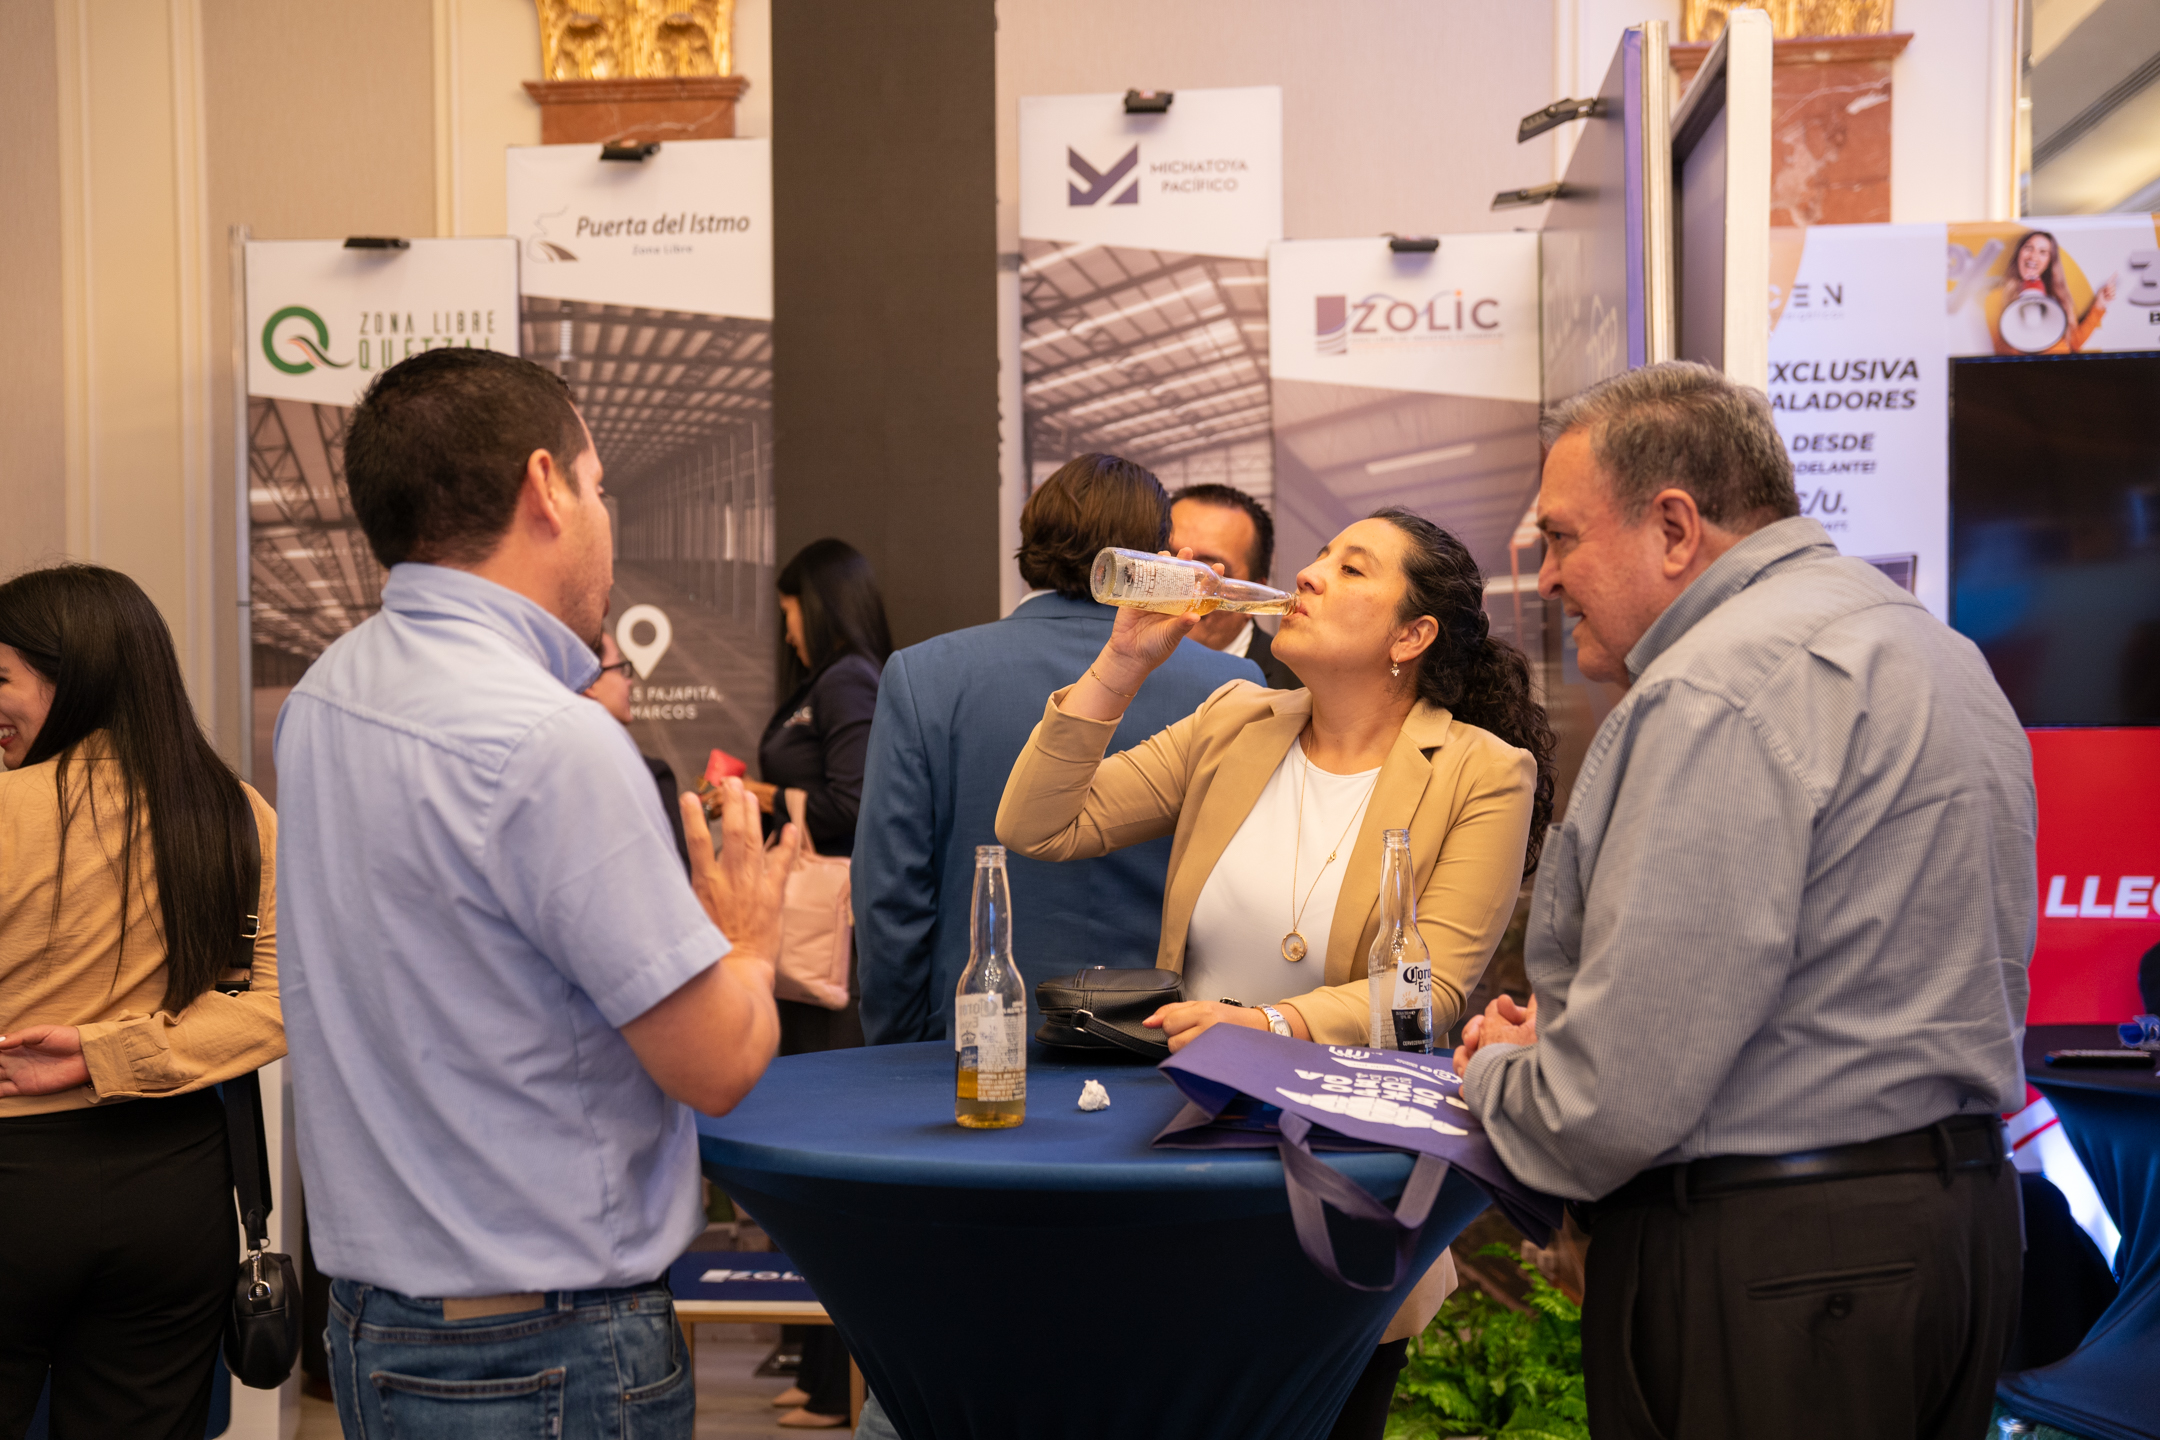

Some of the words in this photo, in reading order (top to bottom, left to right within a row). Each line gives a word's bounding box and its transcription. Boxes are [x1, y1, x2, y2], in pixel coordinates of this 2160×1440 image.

[1149, 160, 1248, 174] MICHATOYA
[576, 214, 647, 238] Puerta
[652, 211, 686, 236] del
[690, 212, 751, 234] Istmo
[360, 311, 415, 335] ZONA
[433, 310, 496, 334] LIBRE
[1768, 358, 1920, 384] XCLUSIVA
[1771, 389, 1918, 412] ALADORES
[1792, 432, 1875, 453] DESDE
[1793, 460, 1876, 475] DELANTE!
[646, 686, 725, 703] PAJAPITA,
[629, 703, 698, 720] MARCOS
[2044, 874, 2160, 919] LLE
[728, 1270, 806, 1282] ZOL
